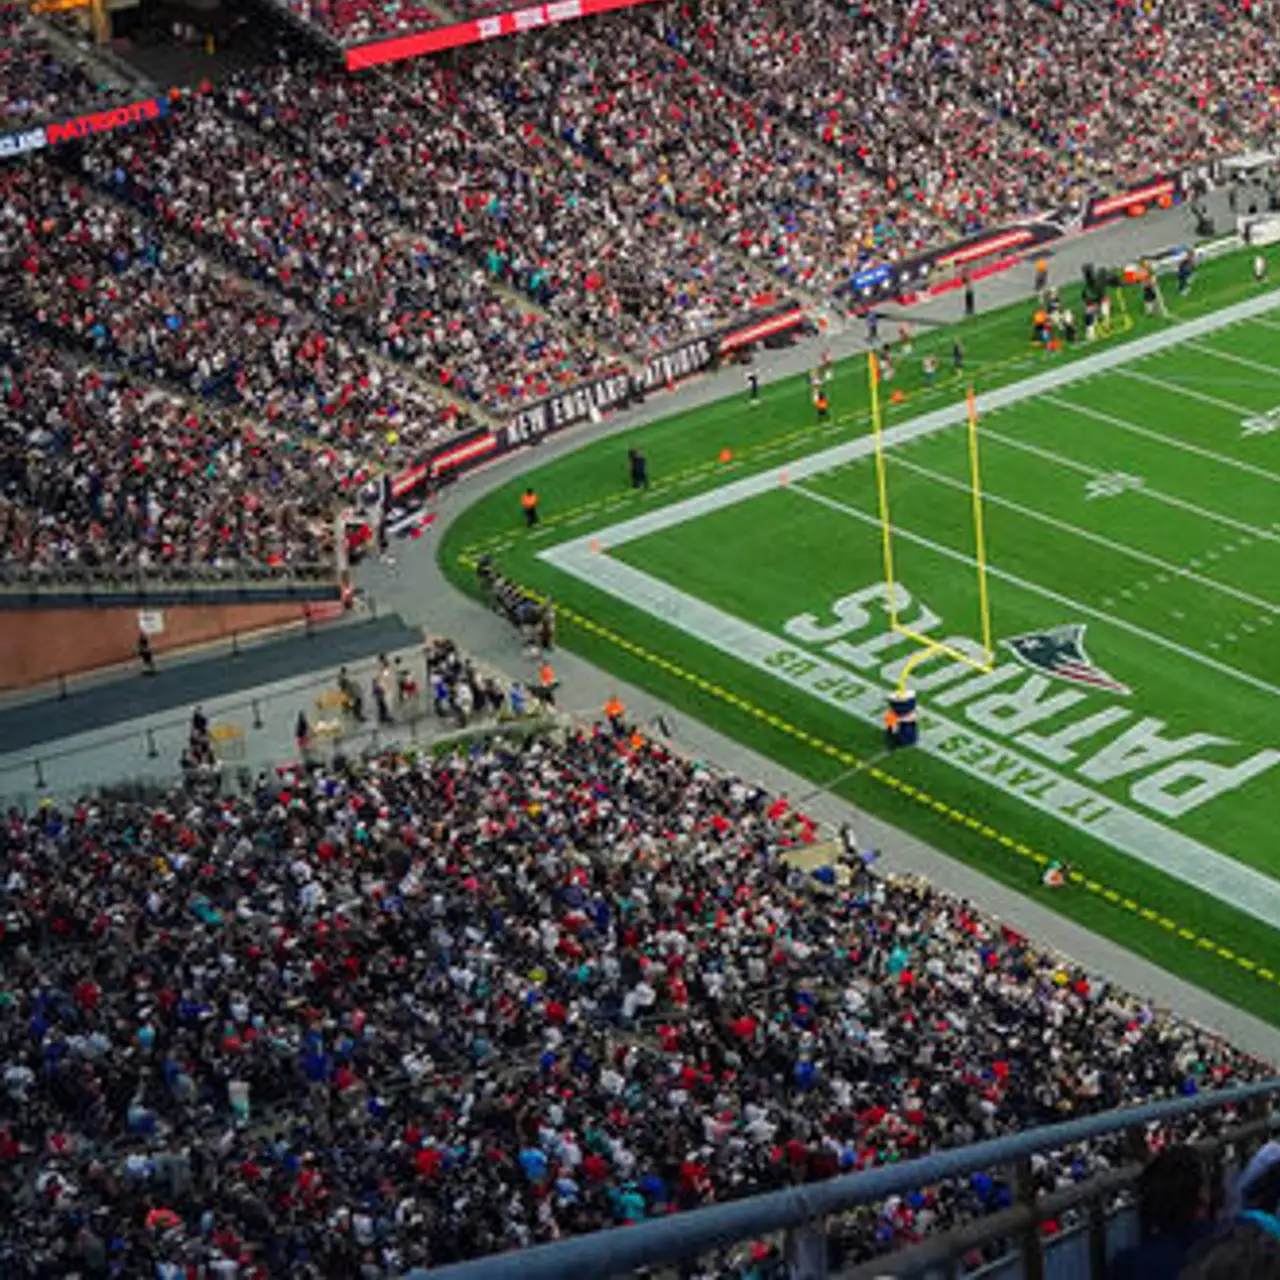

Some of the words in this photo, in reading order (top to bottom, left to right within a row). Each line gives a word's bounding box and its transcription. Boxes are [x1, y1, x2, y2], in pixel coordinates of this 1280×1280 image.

[763, 650, 819, 677] US
[812, 676, 867, 702] OF
[938, 734, 1058, 799] TAKES
[1059, 796, 1112, 824] IT
